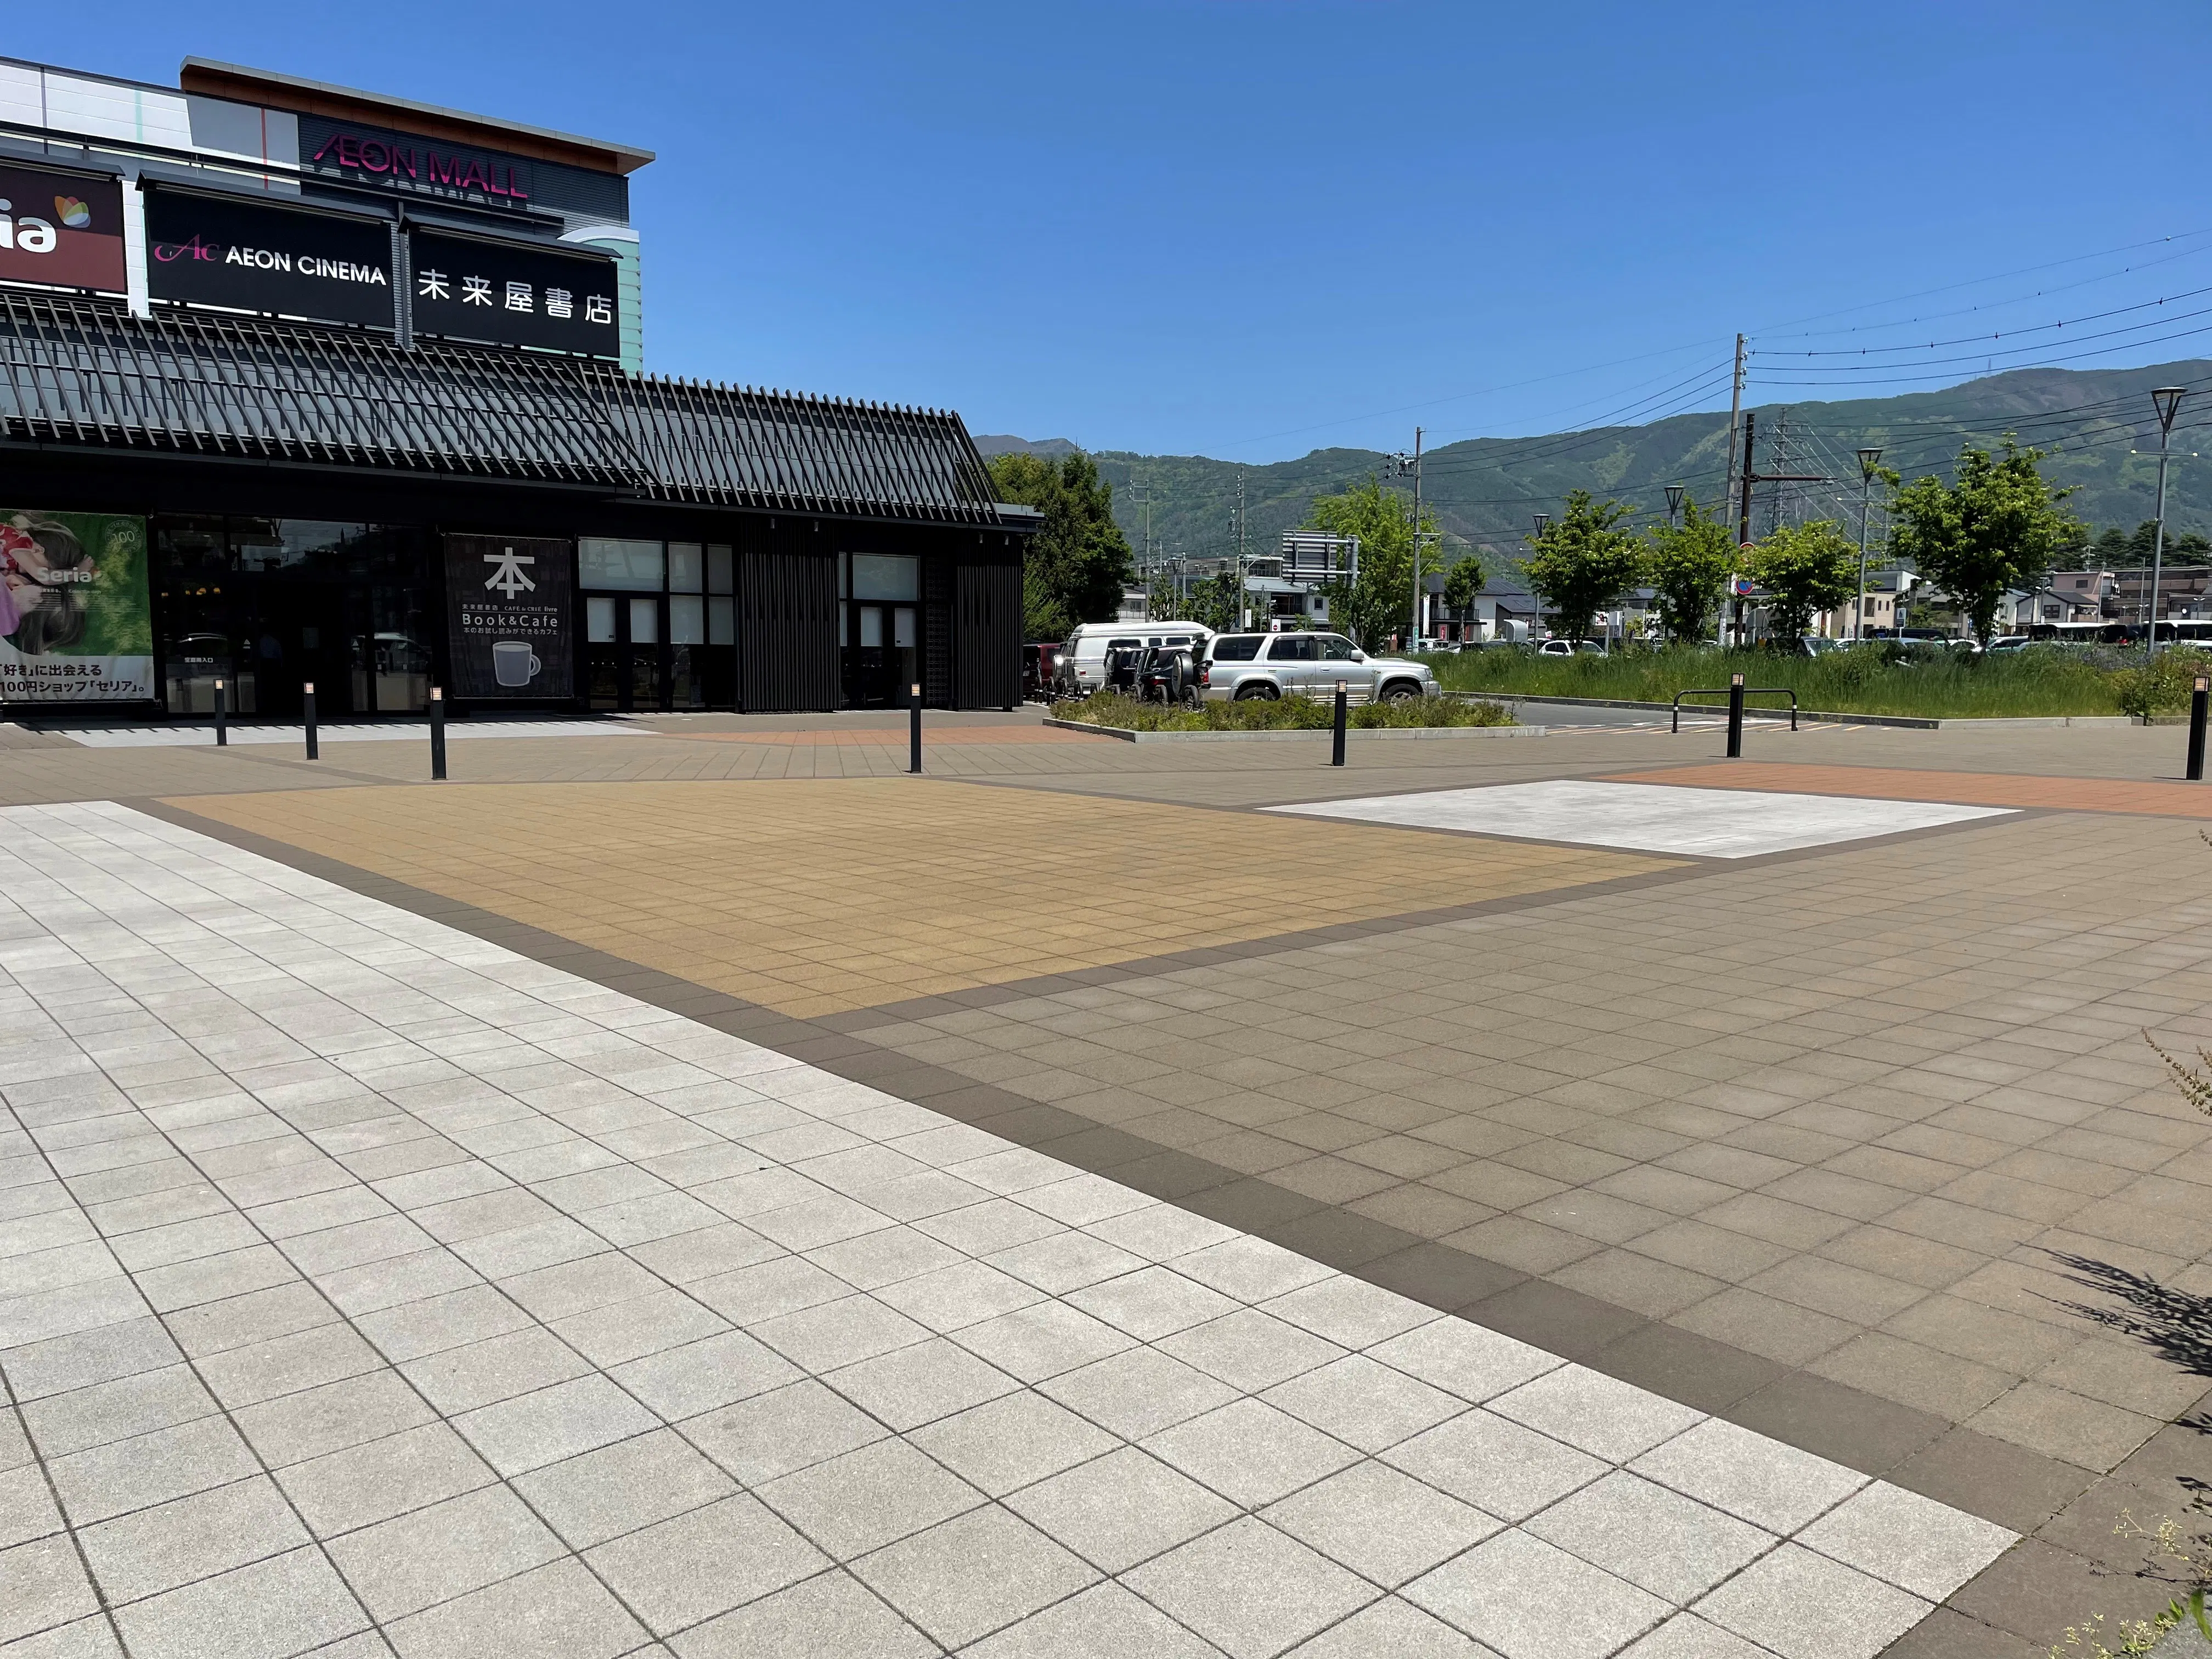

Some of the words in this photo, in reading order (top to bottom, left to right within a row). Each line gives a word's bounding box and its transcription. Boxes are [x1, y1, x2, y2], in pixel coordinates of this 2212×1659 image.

[428, 150, 528, 199] MALL
[225, 246, 291, 272] AEON
[298, 256, 386, 285] CINEMA
[418, 268, 612, 324] 未来屋書店
[112, 531, 135, 543] 100
[37, 567, 92, 583] Seria
[483, 547, 535, 599] 本
